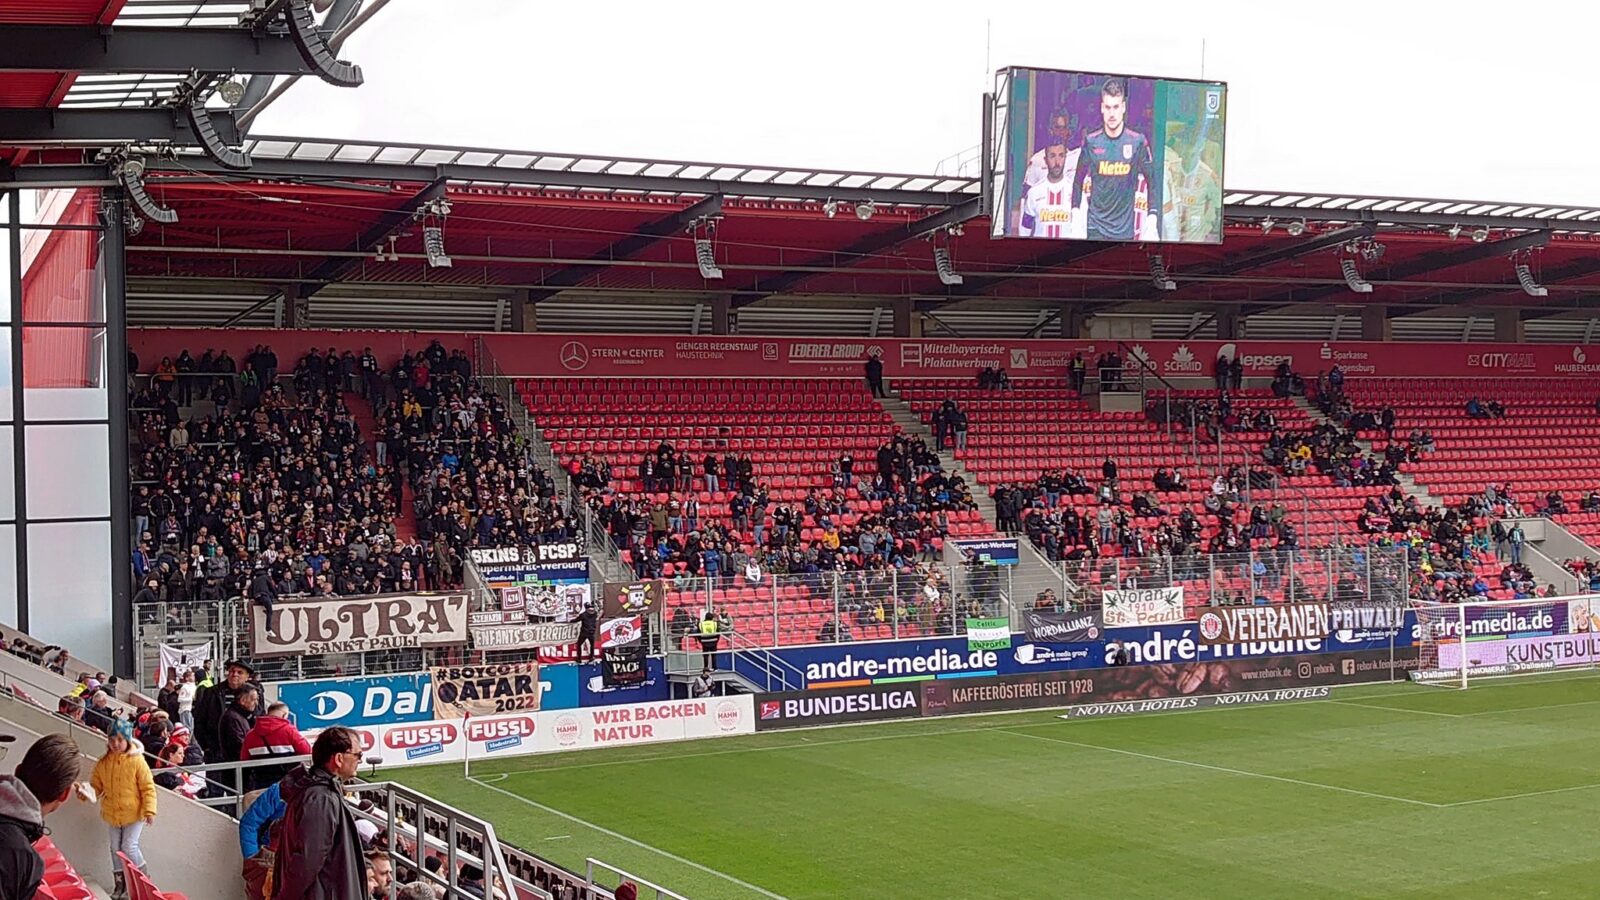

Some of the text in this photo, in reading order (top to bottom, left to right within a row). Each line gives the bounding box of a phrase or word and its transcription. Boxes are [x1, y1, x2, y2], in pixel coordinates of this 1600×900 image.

[1098, 161, 1132, 175] Netto
[1039, 211, 1071, 222] Netto
[591, 348, 665, 358] STERN CENTER
[675, 342, 759, 351] GIENGER REGENSTAUF
[922, 343, 1006, 357] Mittelbayerische
[676, 351, 725, 360] HAUSTECHNIK
[923, 357, 1000, 370] Plakatwerbung
[1030, 357, 1072, 367] Attenkofe
[1332, 350, 1368, 361] Sparkasse
[1122, 361, 1157, 371] CHID
[1164, 361, 1202, 371] SCHMID
[471, 543, 577, 564] SKINS FCSP
[1116, 588, 1164, 604] Voran
[1104, 605, 1183, 625] St. Pauli
[1128, 602, 1155, 612] 1910
[1033, 615, 1095, 639] NORDALLIANZ
[1221, 603, 1330, 641] VETERANEN
[1331, 607, 1405, 630] PRIWALL
[308, 634, 419, 655] SANKT PAULI
[476, 628, 521, 646] ENFANTS
[805, 647, 998, 681] andre-media.de
[1241, 666, 1293, 680] www.rehorik.de
[437, 674, 535, 709] QATAR
[952, 682, 1042, 703] KAFFEERÖSTEREI
[1044, 680, 1067, 696] SEIT
[1069, 678, 1094, 694] 1928
[1214, 687, 1330, 706] NOVINA HOTELS
[496, 696, 535, 713] 2022
[785, 690, 918, 719] BUNDESLIGA
[1075, 697, 1199, 717] NOVINA HOTELS
[592, 702, 707, 725] WIR BACKEN
[717, 711, 738, 721] HAHN
[391, 726, 453, 746] FUSSL
[471, 719, 531, 739] FUSSL
[556, 725, 578, 734] HAHN
[593, 724, 654, 743] NATUR
